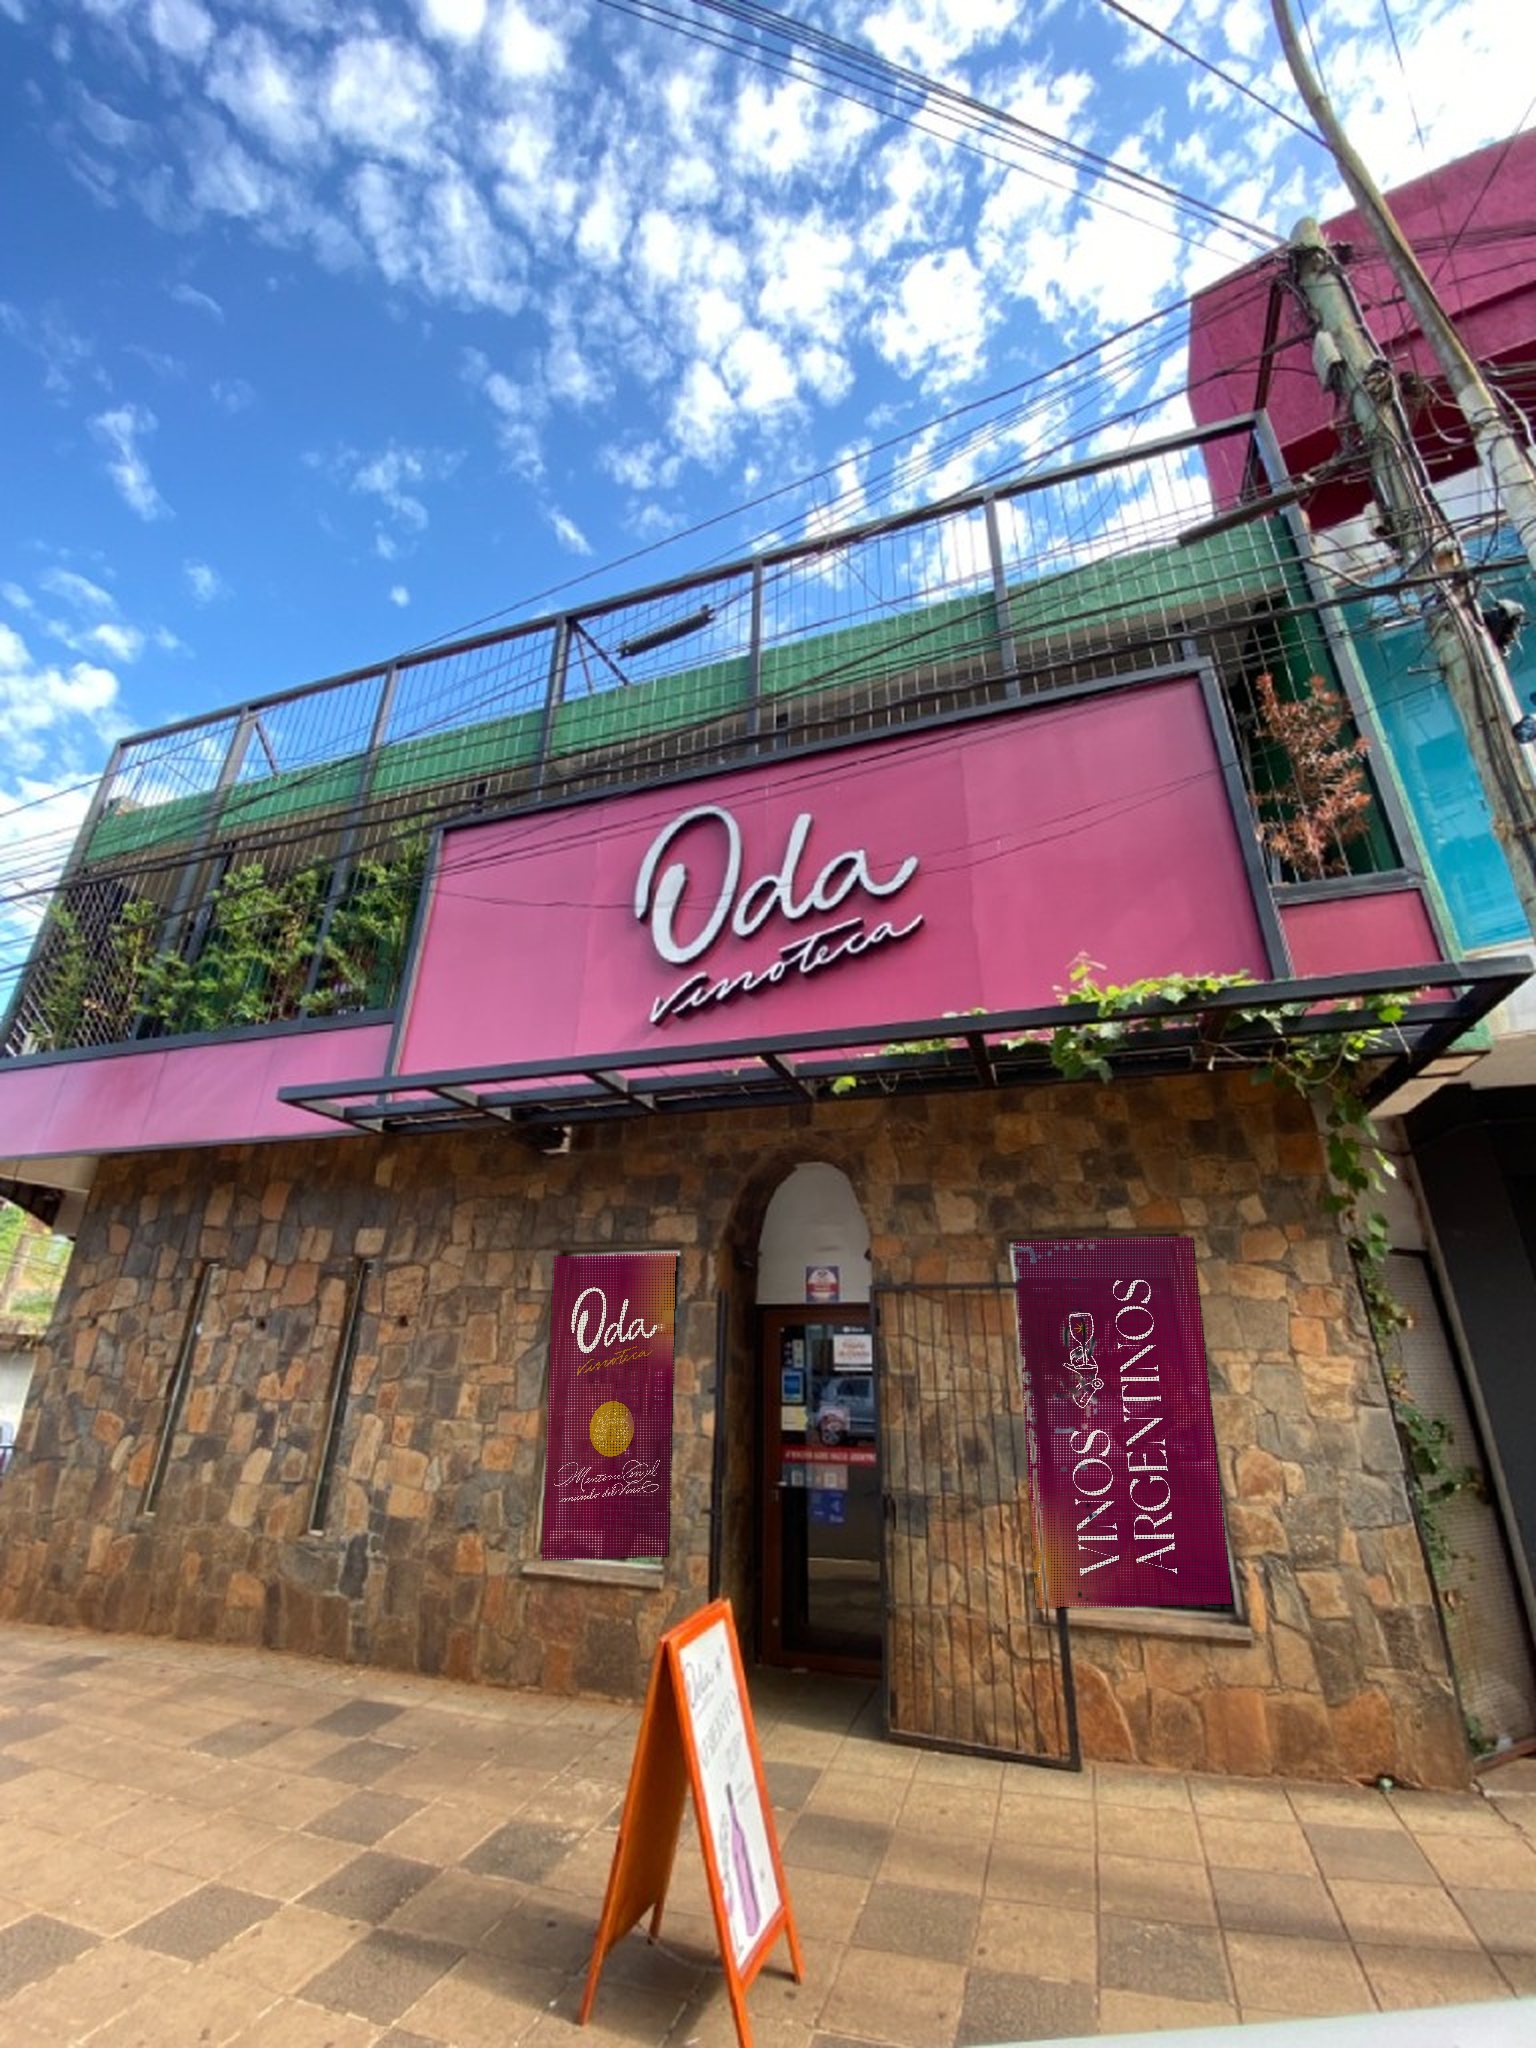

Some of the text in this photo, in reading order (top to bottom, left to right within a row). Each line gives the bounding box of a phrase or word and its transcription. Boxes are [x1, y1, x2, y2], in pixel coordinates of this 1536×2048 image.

[634, 805, 919, 965] Oda
[570, 1286, 659, 1354] Oda
[1070, 1428, 1120, 1577] VINOS
[1112, 1278, 1178, 1575] ARGENTINOS
